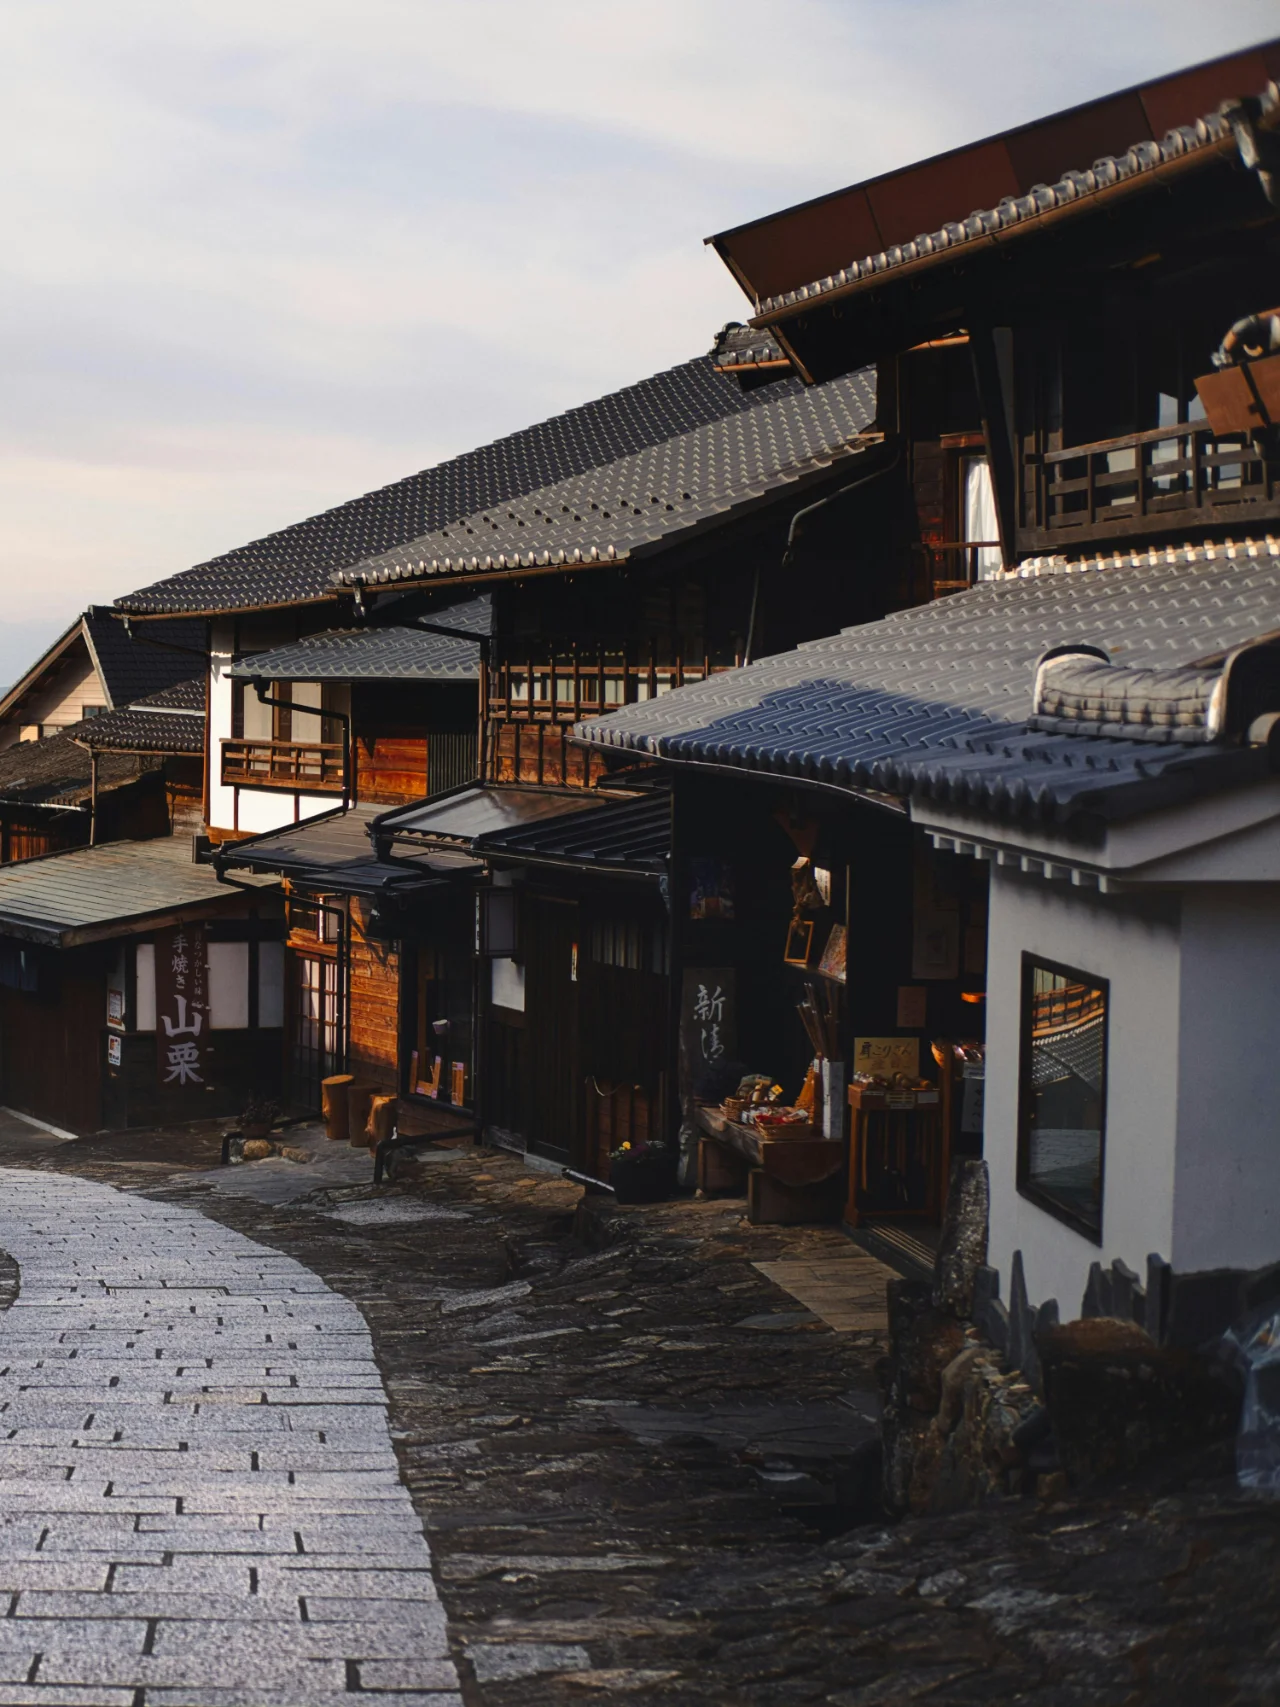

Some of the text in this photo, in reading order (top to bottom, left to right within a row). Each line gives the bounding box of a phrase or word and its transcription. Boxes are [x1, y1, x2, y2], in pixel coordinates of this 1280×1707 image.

[160, 934, 205, 1085] 手焼き山栗
[693, 984, 726, 1064] 新清
